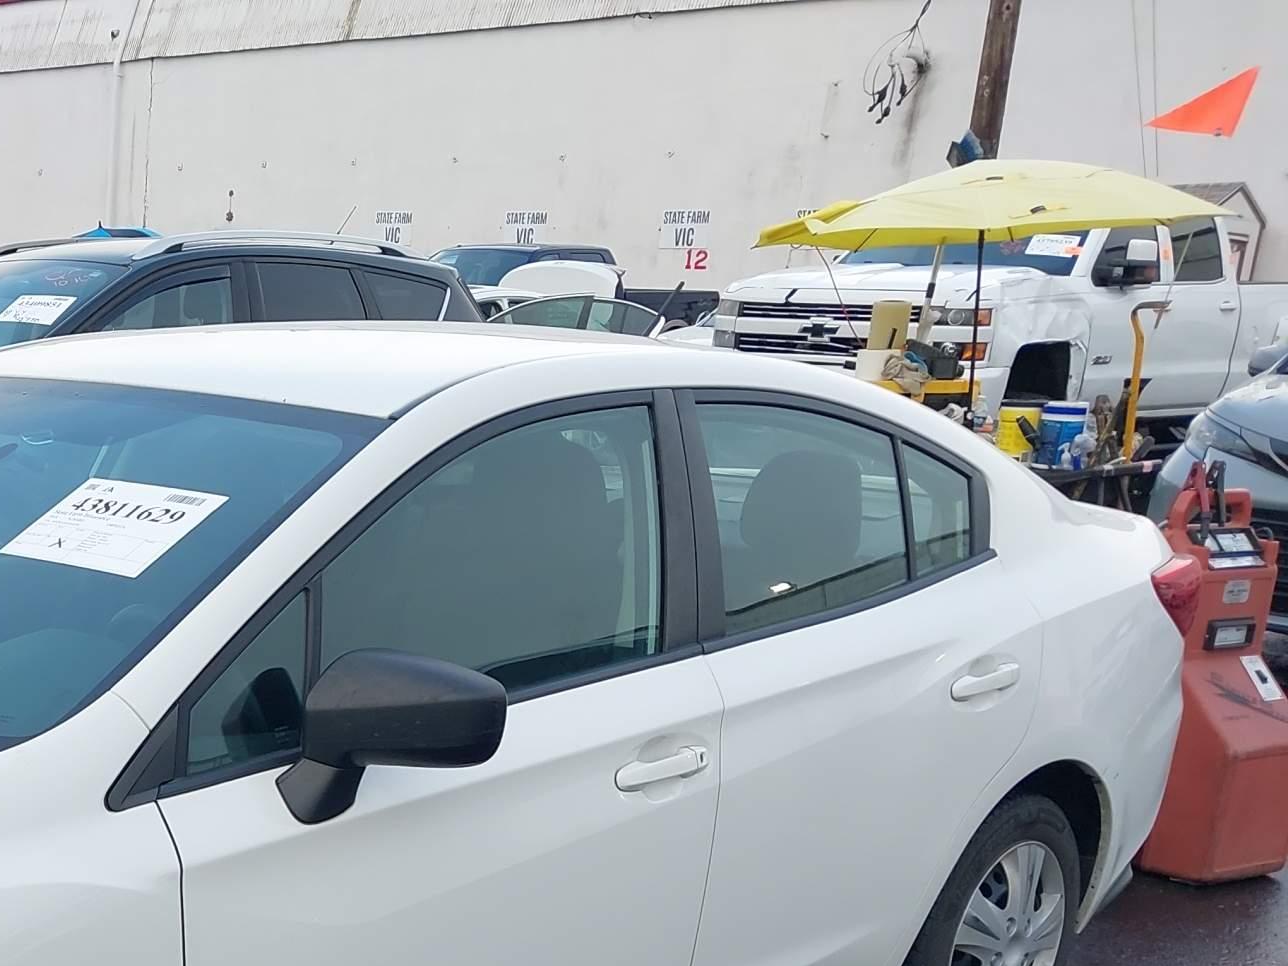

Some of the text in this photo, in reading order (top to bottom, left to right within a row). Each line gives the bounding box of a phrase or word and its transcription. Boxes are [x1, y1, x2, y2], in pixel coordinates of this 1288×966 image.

[376, 212, 412, 224] STATE FARM
[506, 212, 547, 224] STATE FARM
[664, 211, 710, 224] STATE FARM
[385, 227, 400, 244] VIC
[517, 228, 534, 244] VIC
[675, 228, 695, 247] VIC
[685, 249, 708, 269] 12
[72, 497, 186, 525] 43811629
